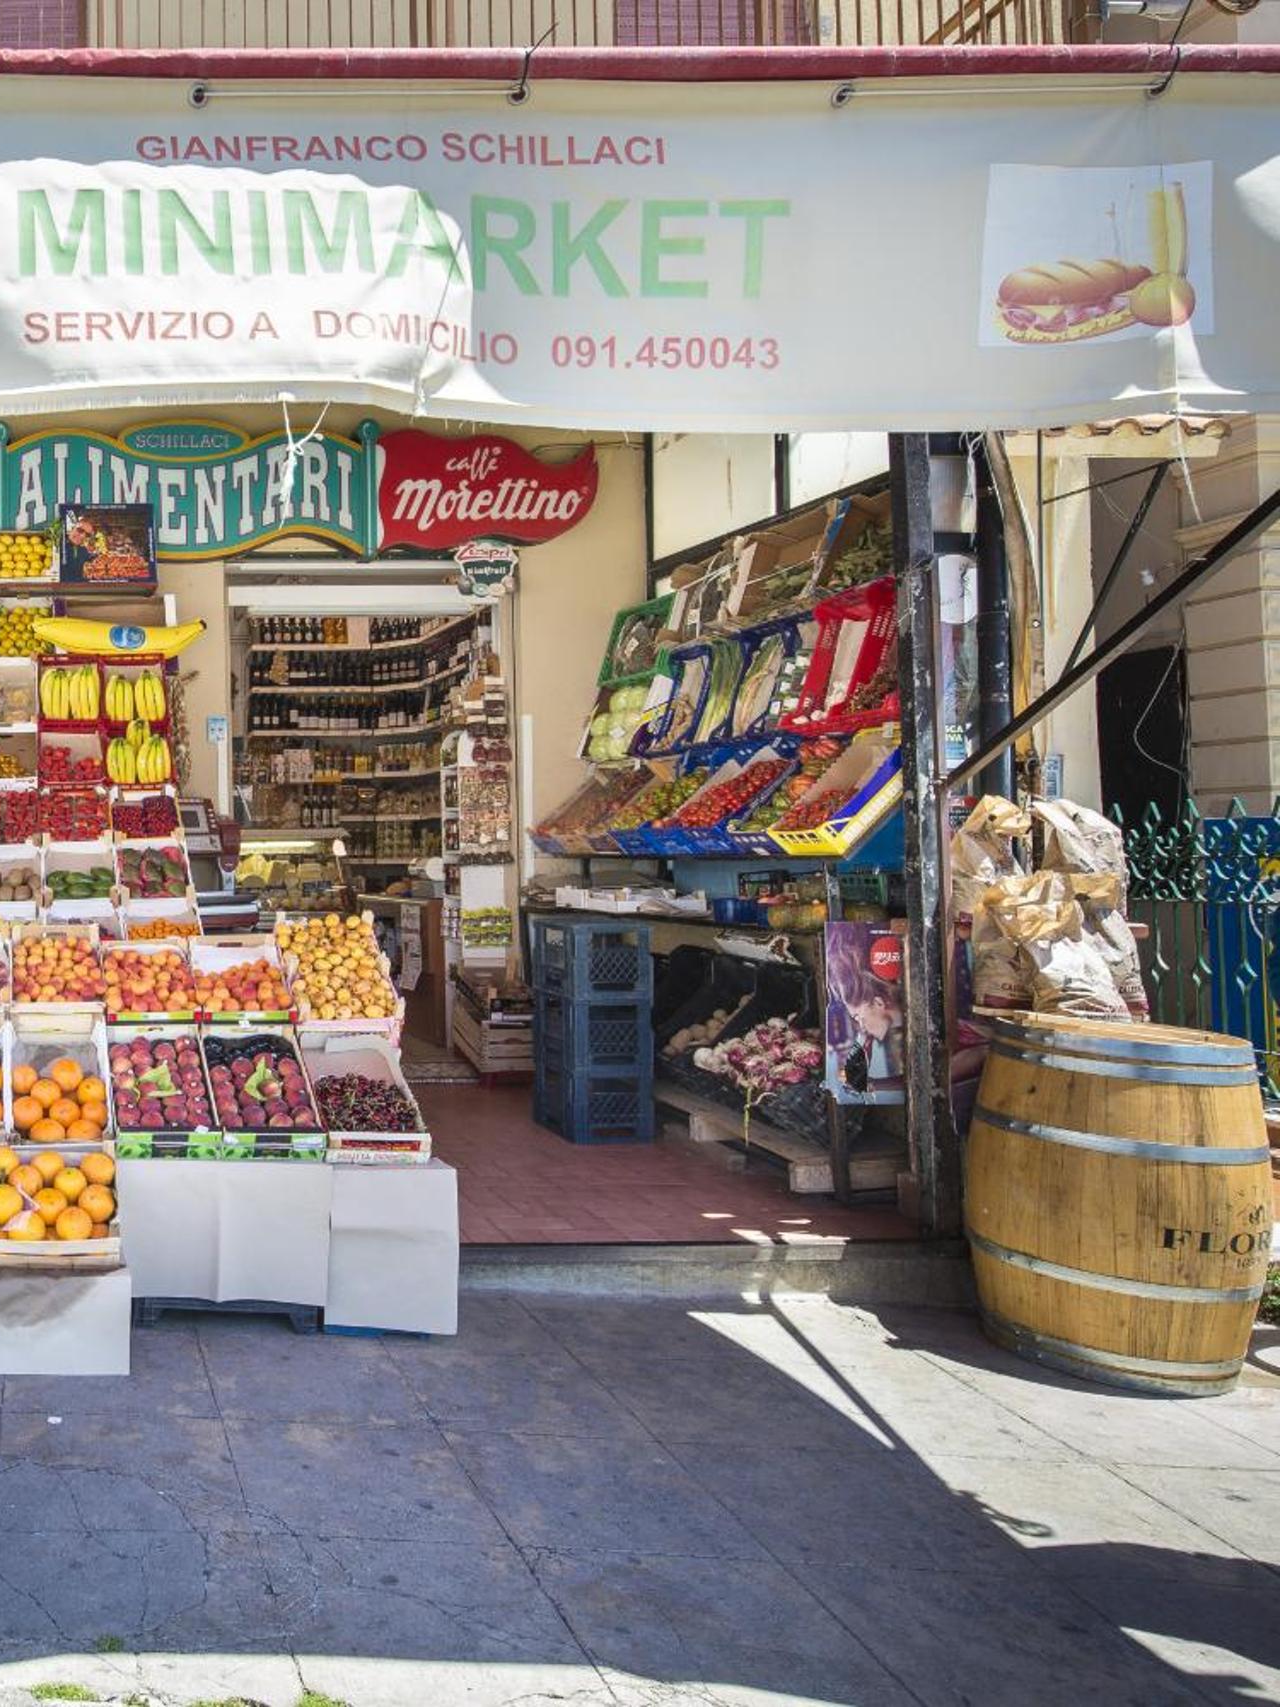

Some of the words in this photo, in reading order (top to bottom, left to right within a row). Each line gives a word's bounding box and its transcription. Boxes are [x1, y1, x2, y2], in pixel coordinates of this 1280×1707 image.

[135, 134, 429, 163] GIANFRANCO
[441, 132, 666, 167] SCHILLACI
[17, 187, 792, 300] MINIMARKET
[23, 310, 235, 346] SERVIZIO
[247, 311, 280, 341] A
[313, 308, 519, 366] DOMICILIO
[550, 334, 781, 371] 091.450043
[134, 432, 230, 451] SCHILLACI
[15, 440, 355, 547] ALIMENTARI
[392, 477, 584, 532] Morettino
